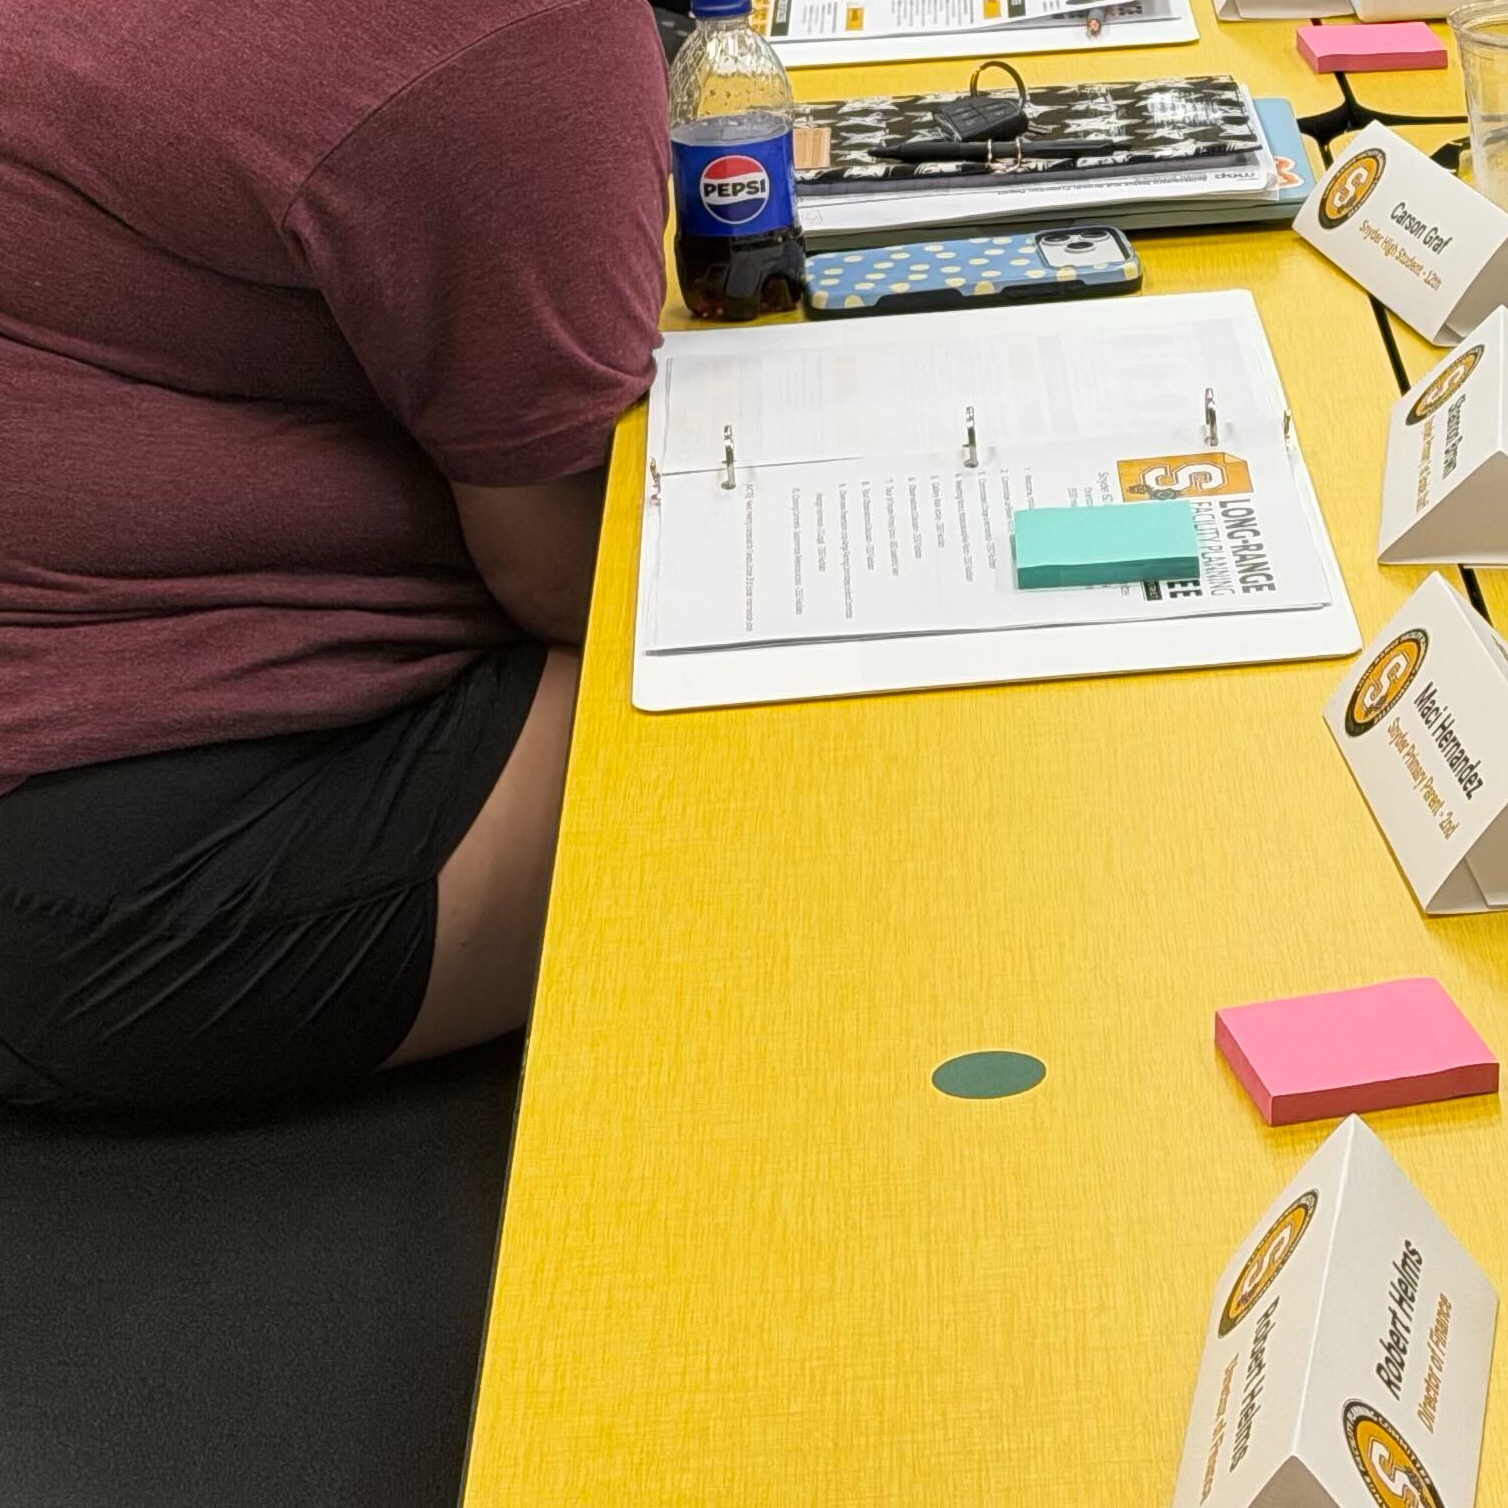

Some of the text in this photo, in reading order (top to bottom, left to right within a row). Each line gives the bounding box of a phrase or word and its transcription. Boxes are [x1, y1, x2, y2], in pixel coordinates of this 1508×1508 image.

[703, 178, 766, 198] PEPSI
[1390, 201, 1453, 256] Carson Graf
[1359, 219, 1385, 244] Snyder
[1381, 235, 1398, 257] High
[1395, 247, 1424, 278] Student
[1200, 545, 1236, 596] PLANNING
[1219, 498, 1276, 594] LONG-RANGE
[1387, 716, 1409, 754] Snyder
[1402, 743, 1427, 790] Primary
[1420, 776, 1446, 817] Parent
[1438, 810, 1460, 841] 2nd
[1413, 681, 1484, 801] Maci Hernandez
[1376, 1240, 1423, 1401] Robert Helms
[1417, 1293, 1452, 1434] Director of Finance
[1229, 1295, 1280, 1473] Robert Helms
